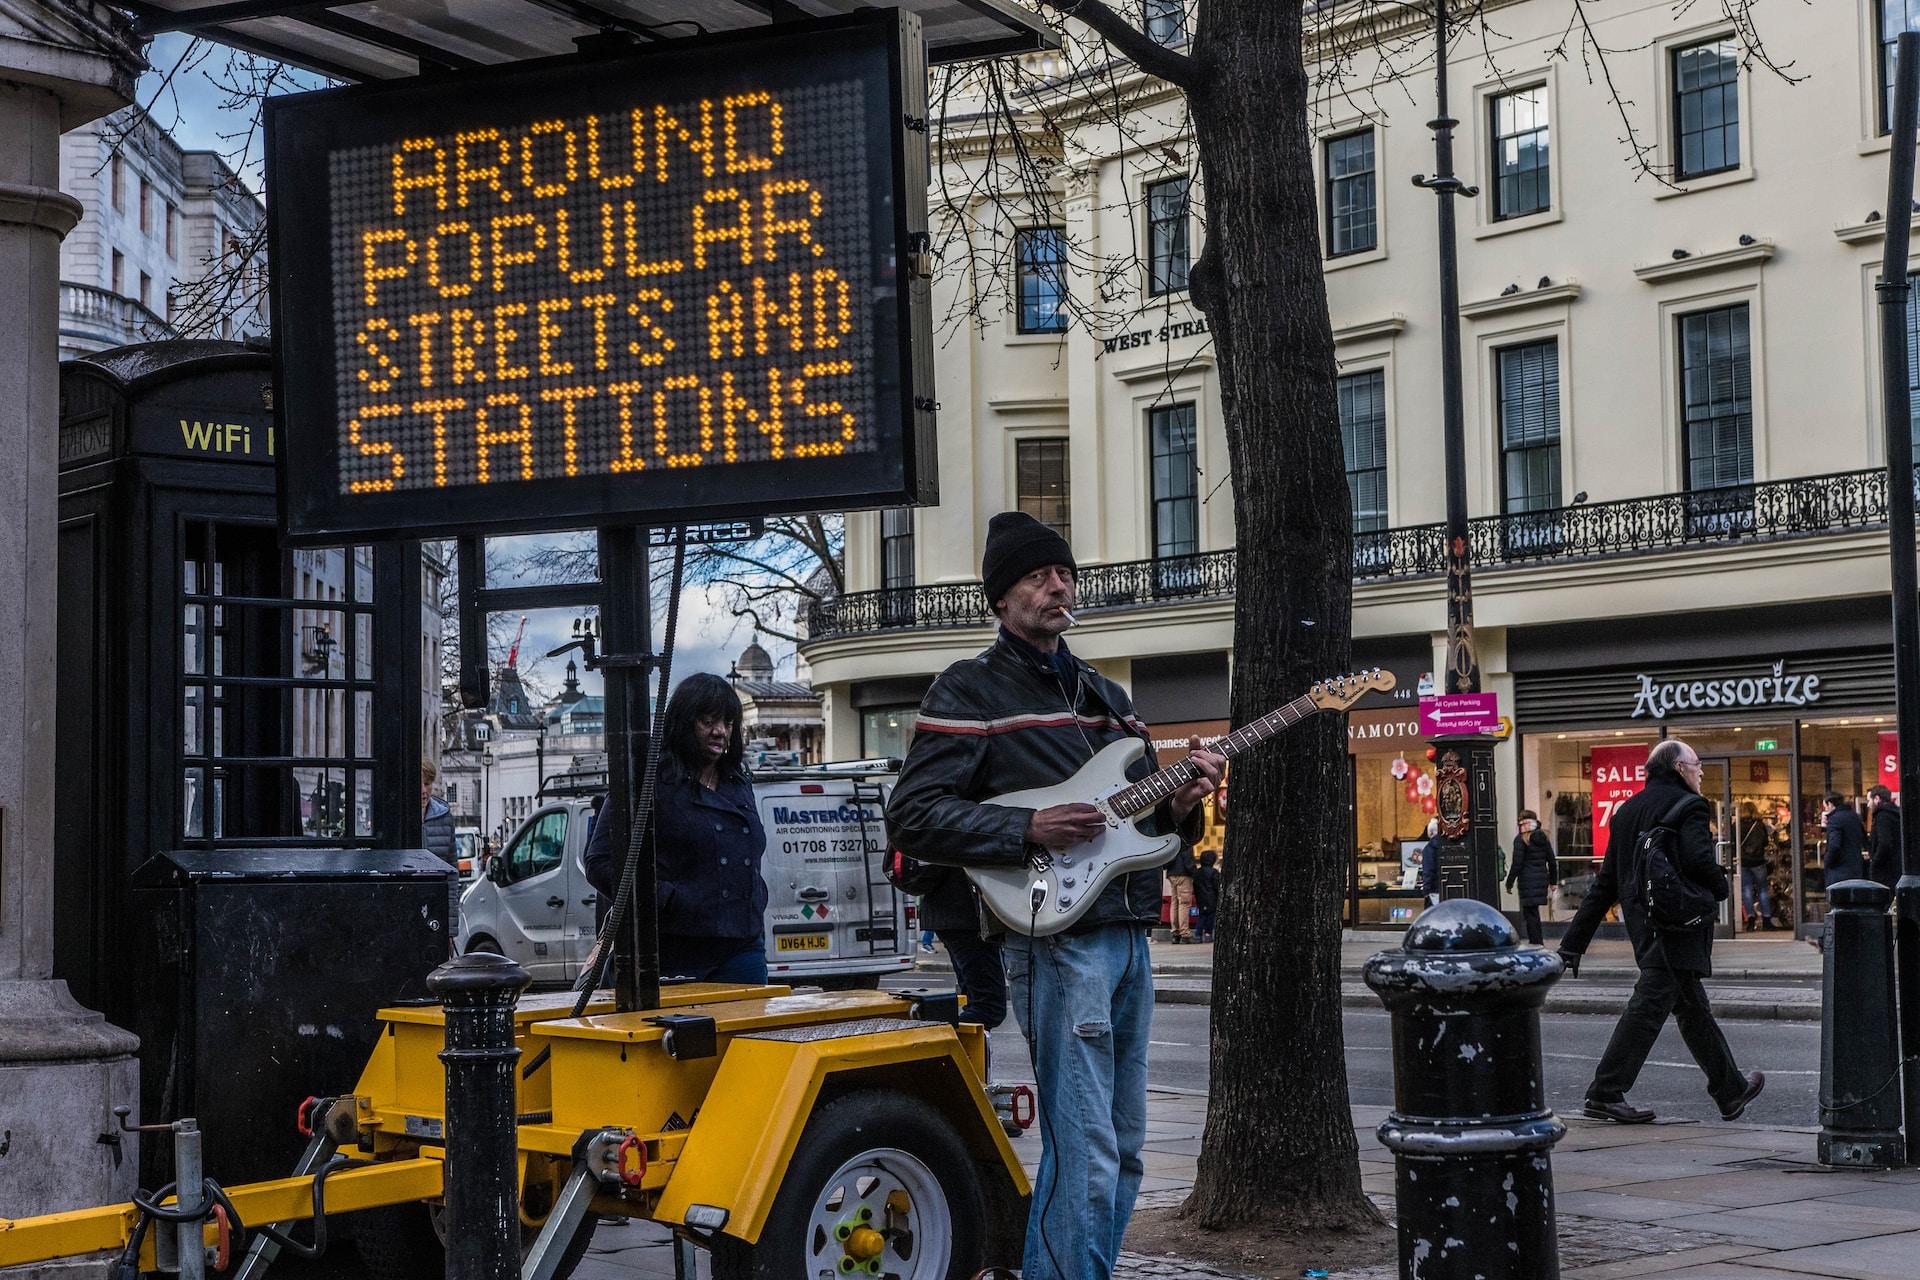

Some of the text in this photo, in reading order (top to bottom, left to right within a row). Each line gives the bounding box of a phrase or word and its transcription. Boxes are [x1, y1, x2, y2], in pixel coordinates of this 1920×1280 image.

[393, 91, 783, 215] AROUND
[363, 180, 825, 306] POPULAR
[356, 267, 851, 391] STREETS AND
[1103, 318, 1211, 354] WEST STRA
[180, 419, 250, 454] WiFi
[349, 360, 855, 493] STATIONS
[1393, 688, 1411, 699] 448
[1631, 660, 1820, 718] Accessorize
[1150, 738, 1189, 752] apanese
[1596, 765, 1646, 783] SALE
[1609, 789, 1633, 798] UP TO
[776, 825, 880, 835] AIR CONDITIONING SPECILISTS
[783, 839, 878, 854] 01708 732700
